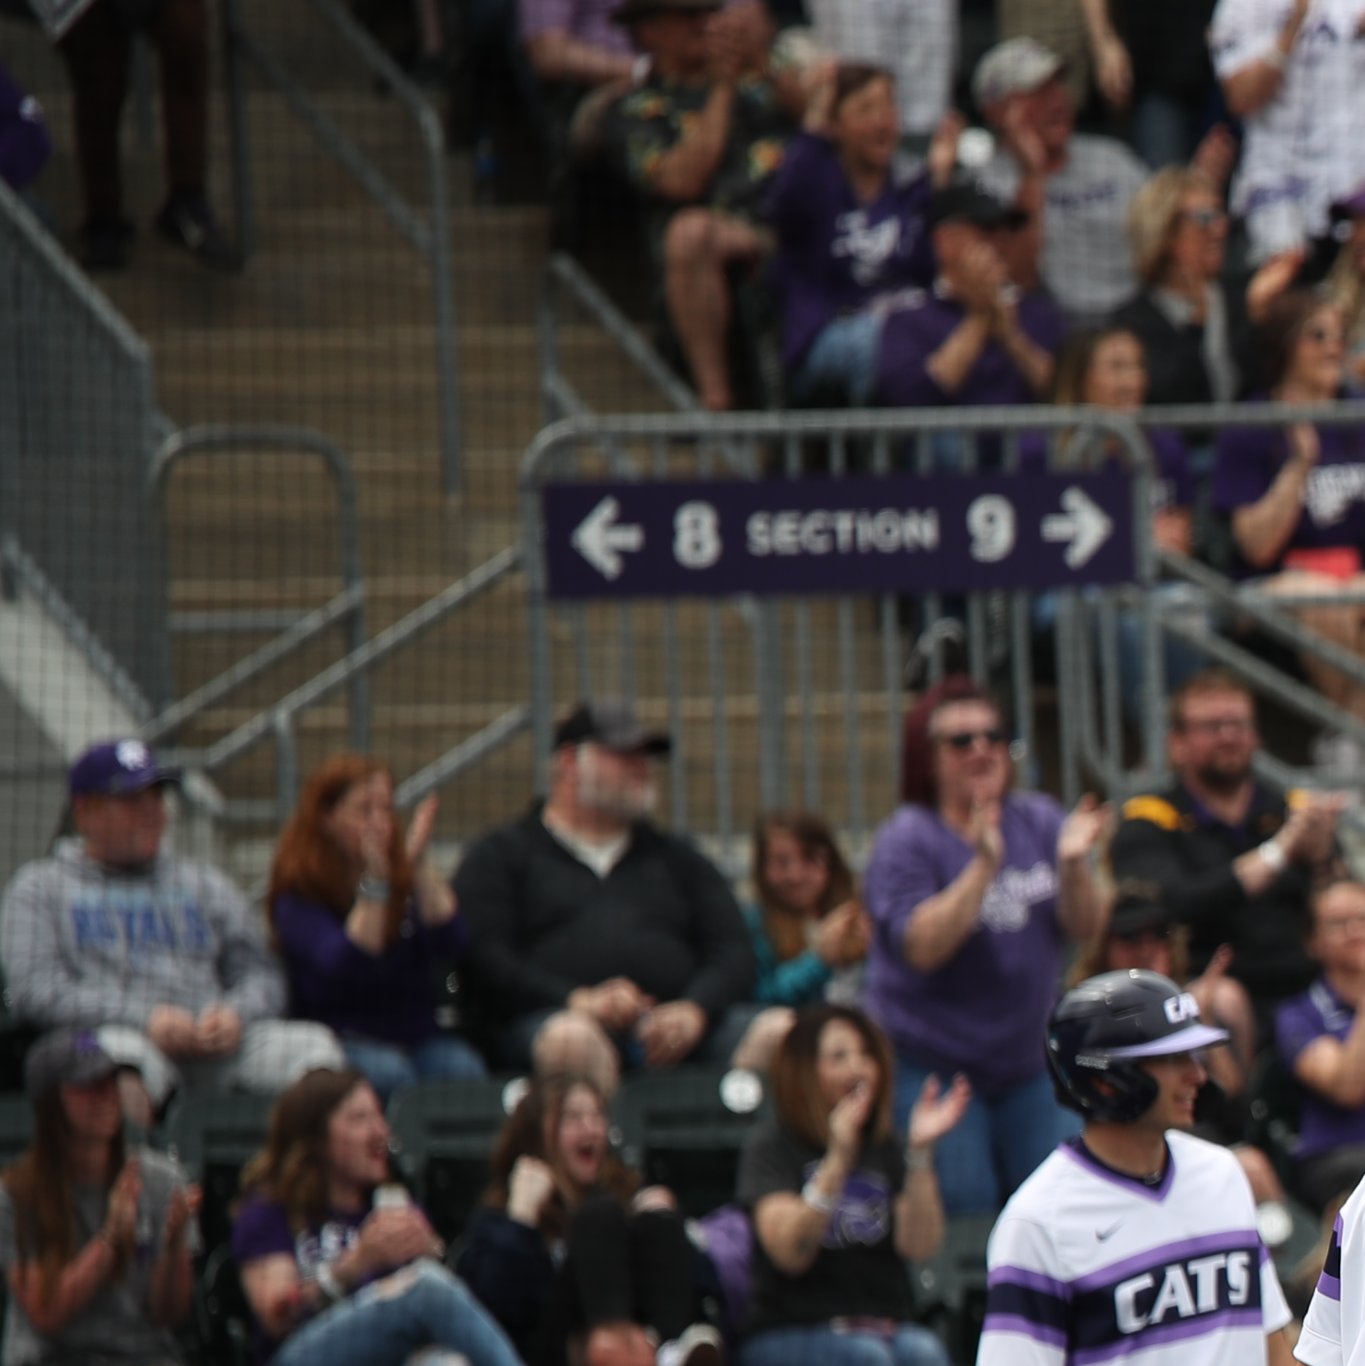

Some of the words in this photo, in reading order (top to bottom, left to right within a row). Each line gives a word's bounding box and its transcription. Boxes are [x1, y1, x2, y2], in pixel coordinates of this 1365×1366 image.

[672, 501, 722, 570] 8
[746, 509, 939, 556] SECTION
[966, 493, 1016, 562] 9
[1114, 1251, 1250, 1334] CATS
